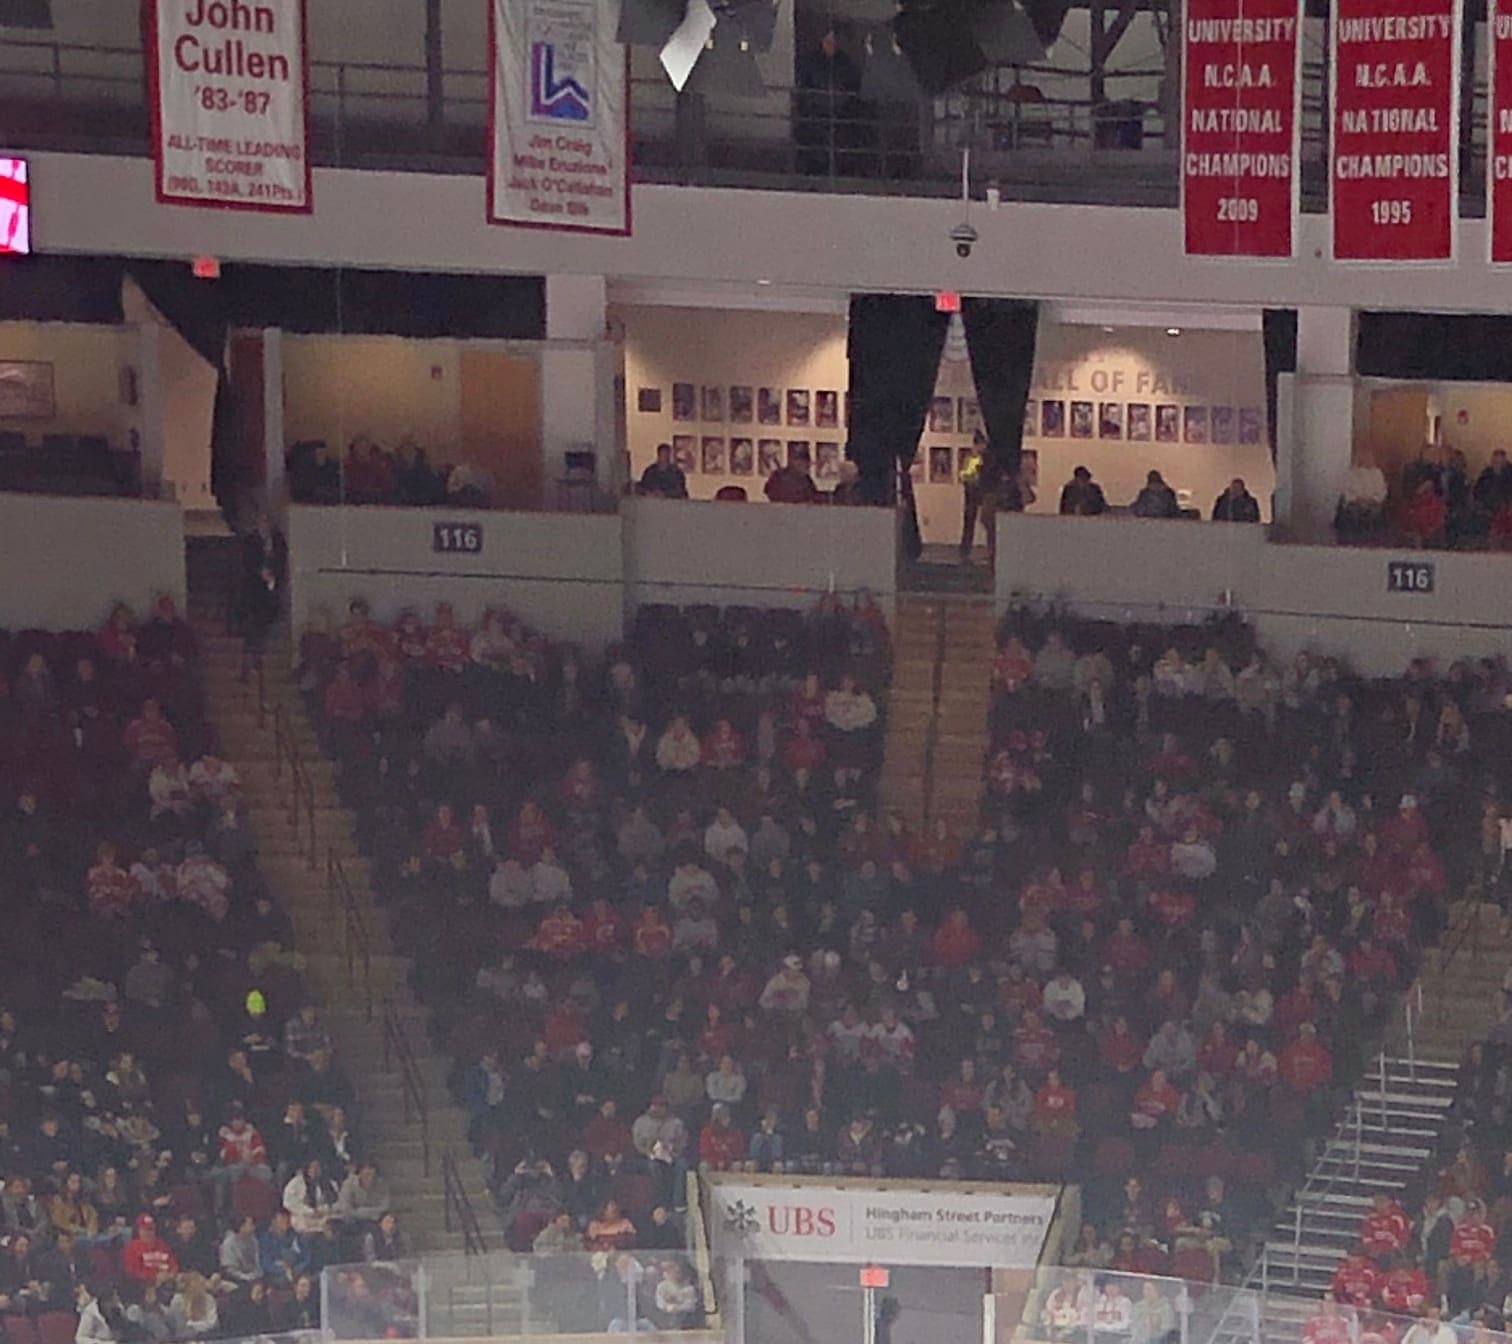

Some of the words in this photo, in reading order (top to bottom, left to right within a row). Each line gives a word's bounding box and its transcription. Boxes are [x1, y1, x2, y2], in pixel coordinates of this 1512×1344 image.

[185, 0, 275, 33] John
[1188, 17, 1296, 45] UNIVERSITY
[1339, 15, 1451, 43] UNIVERSITY
[174, 34, 289, 81] Cullen
[1355, 62, 1432, 87] N.C.A.A.
[1192, 109, 1283, 133] NATIONAL
[1343, 109, 1439, 133] NATIONAL
[205, 158, 263, 177] SCORER
[1187, 153, 1291, 178] CHAMPIONS
[1337, 154, 1449, 179] CHAMPIONS
[1217, 199, 1258, 222] 2009
[1371, 200, 1412, 224] 1995
[1090, 370, 1125, 394] OF
[440, 528, 477, 549] 116
[1393, 568, 1428, 588] 116
[768, 1205, 836, 1237] UBS
[866, 1207, 933, 1223] Hingham
[936, 1208, 980, 1223] Street
[984, 1210, 1044, 1225] Partners
